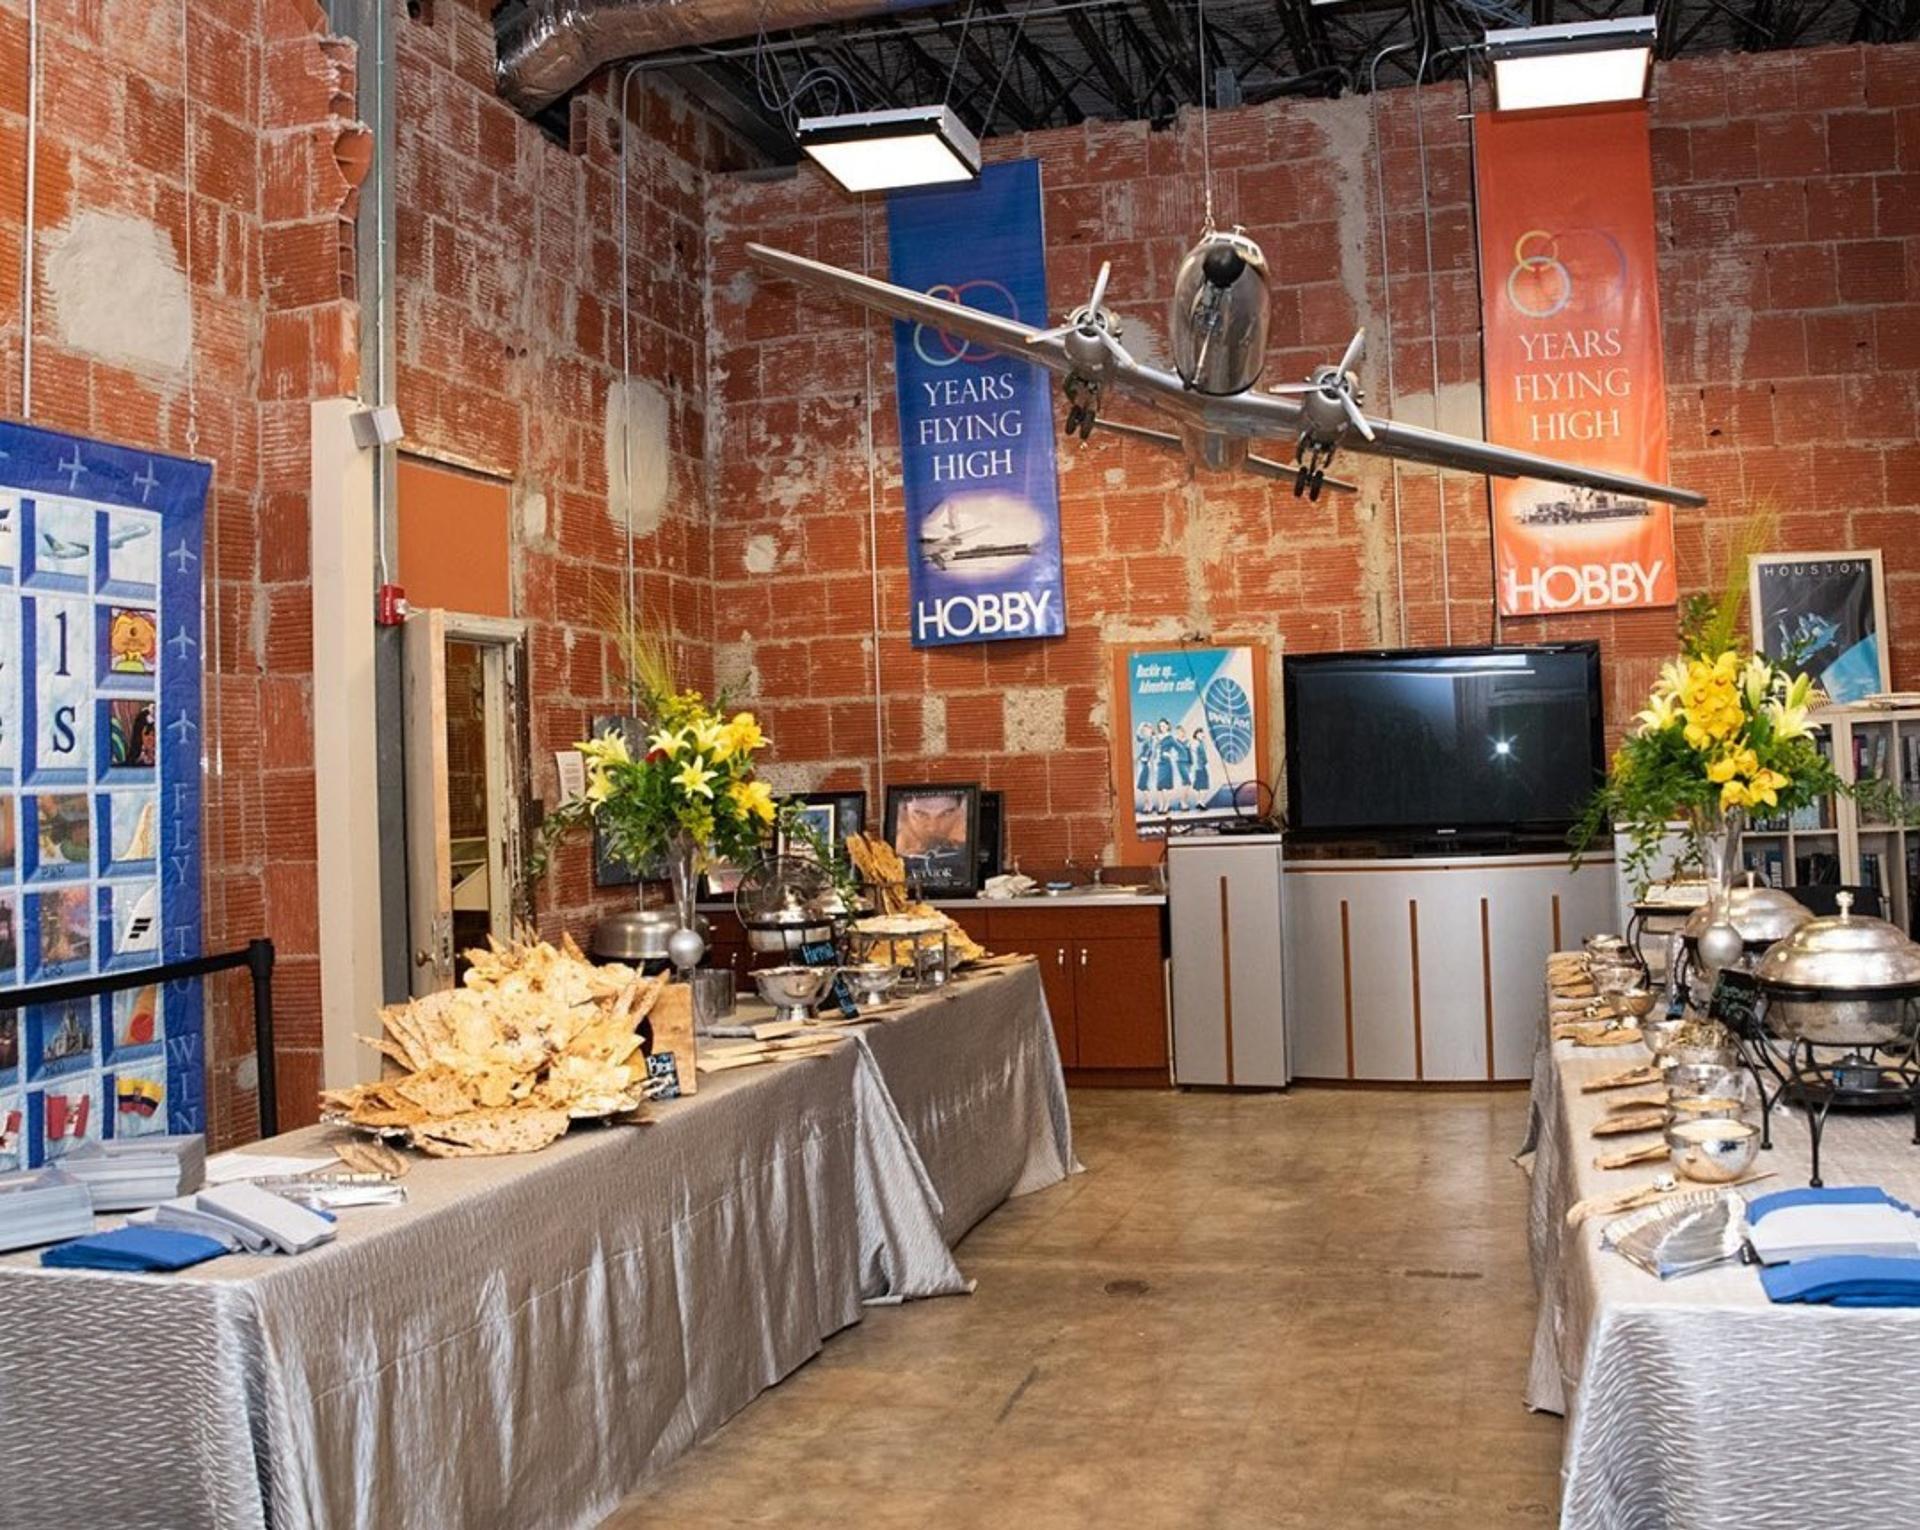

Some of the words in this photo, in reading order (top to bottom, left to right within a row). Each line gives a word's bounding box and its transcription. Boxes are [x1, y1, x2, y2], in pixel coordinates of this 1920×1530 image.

[1518, 328, 1621, 361] YEARS
[923, 373, 1014, 406] YEARS
[1514, 368, 1632, 402] FLYING
[919, 410, 1022, 445] FLYING
[1531, 408, 1621, 441] HIGH
[932, 449, 1014, 481] HIGH
[1507, 559, 1663, 612] HOBBY
[1764, 562, 1865, 576] HOUSTON
[918, 590, 1052, 640] HOBBY
[170, 783, 192, 887] FLY
[168, 1033, 201, 1134] WIN
